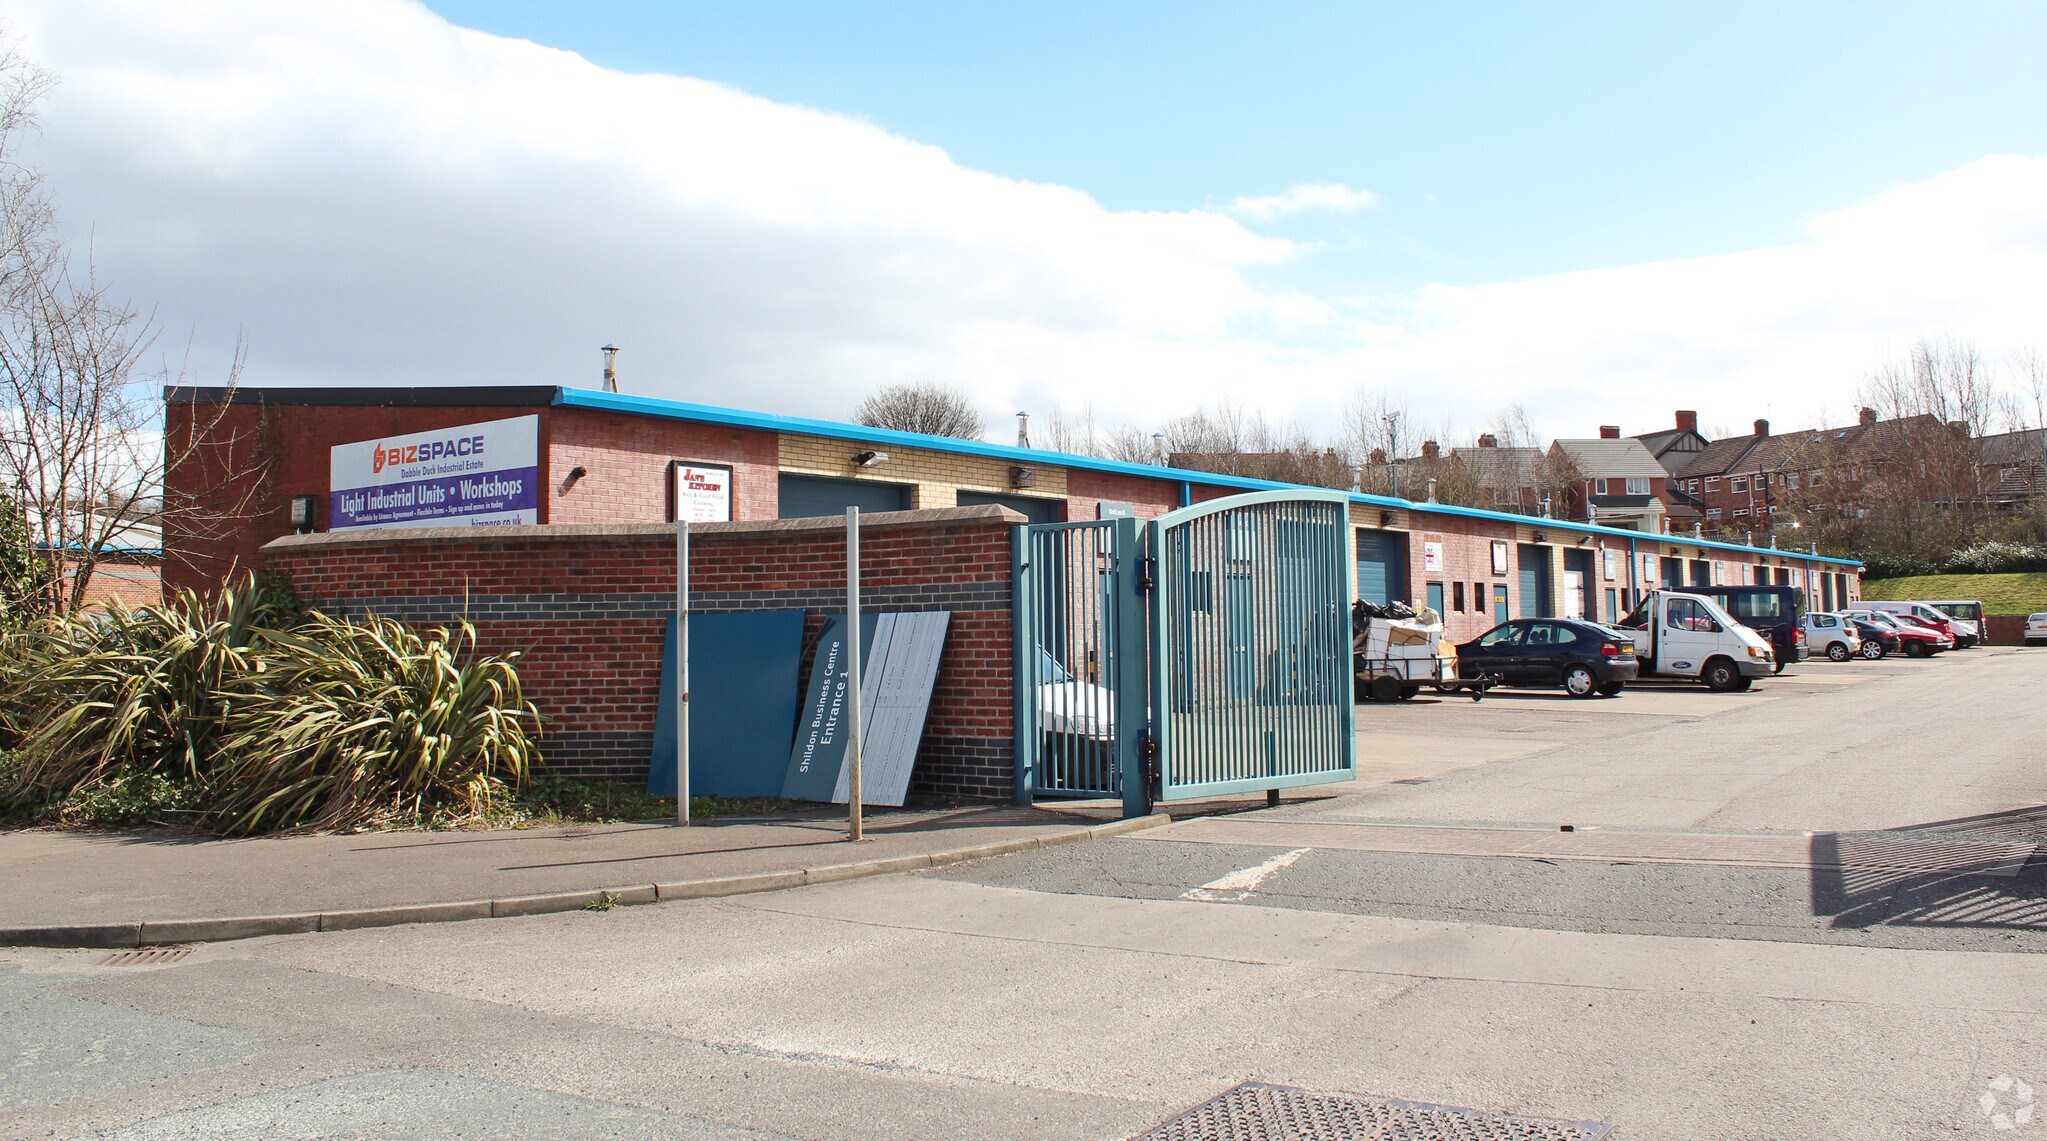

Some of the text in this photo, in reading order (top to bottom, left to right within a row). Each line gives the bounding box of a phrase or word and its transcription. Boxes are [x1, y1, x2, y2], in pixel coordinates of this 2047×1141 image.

[388, 436, 484, 466] BIZSPACE
[402, 459, 484, 478] Dabble Duck Industrial Estate
[341, 475, 522, 518] Light Industrial Units Workshops
[448, 505, 458, 514] Sign
[464, 503, 472, 511] and
[491, 500, 503, 509] today
[472, 514, 522, 526] bizspacecouk
[800, 641, 839, 772] Shildon Business Centre
[820, 682, 846, 745] Entrance
